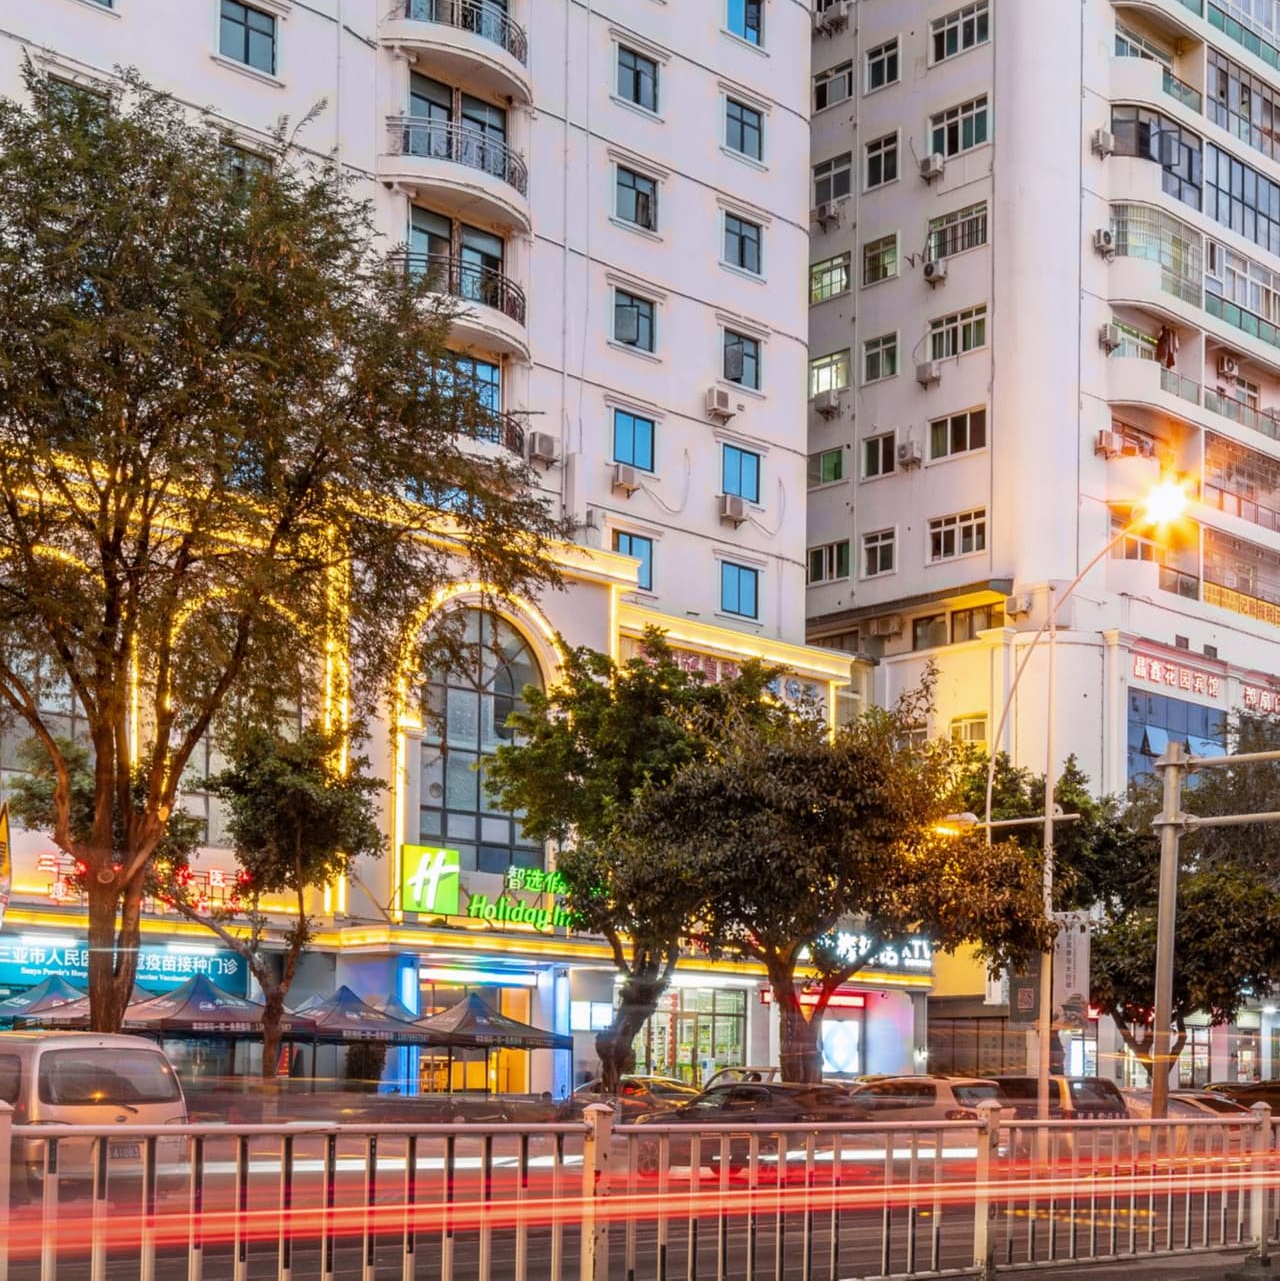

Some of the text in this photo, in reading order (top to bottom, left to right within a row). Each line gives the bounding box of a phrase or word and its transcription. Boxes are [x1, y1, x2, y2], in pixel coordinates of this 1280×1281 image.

[1134, 655, 1219, 698] 晶鑫花园宾馆
[507, 864, 572, 895] 智选假
[470, 894, 549, 932] Holiday
